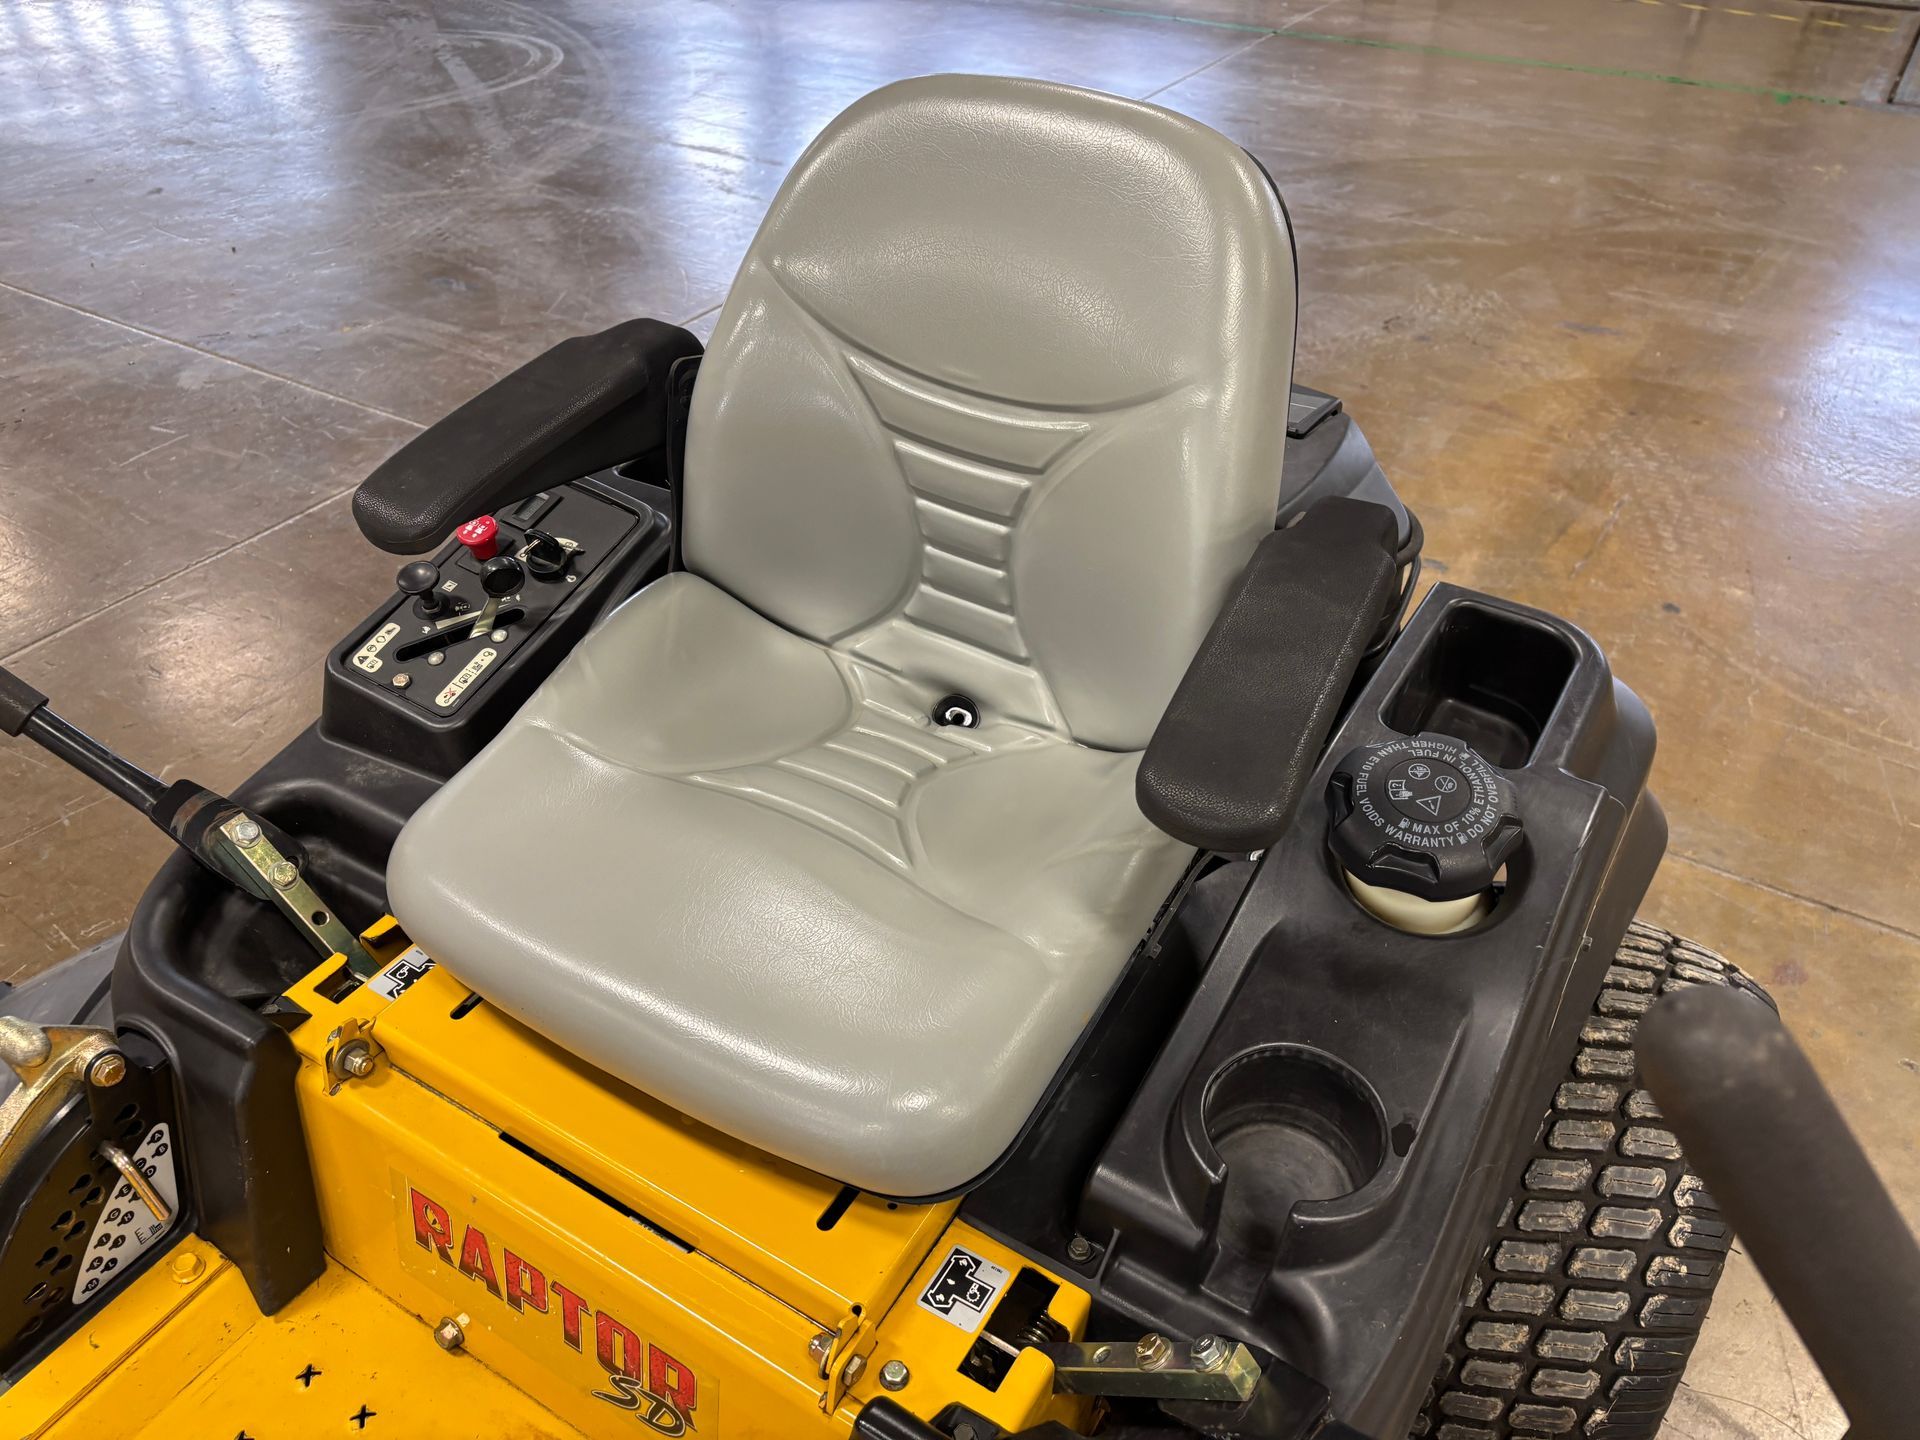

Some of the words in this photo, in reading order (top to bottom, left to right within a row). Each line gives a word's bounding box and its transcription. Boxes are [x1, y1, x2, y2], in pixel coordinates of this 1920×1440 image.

[1377, 742, 1410, 758] THAN
[1407, 749, 1440, 758] FUEL
[1411, 740, 1458, 755] HIGHER
[1362, 755, 1381, 771] E10
[1442, 753, 1457, 764] IN
[1356, 772, 1370, 797] FUEL
[1459, 761, 1485, 806] ETHANOL
[1471, 759, 1499, 804] OVERFILL
[1359, 797, 1385, 827] VOIDS
[1461, 806, 1482, 825] 10%
[1479, 804, 1498, 827] NOT
[1384, 823, 1455, 848] WARRANTY
[1411, 822, 1441, 835] MAX
[1443, 820, 1461, 833] OF
[1466, 823, 1485, 839] DO
[410, 1186, 698, 1432] RAPTOR
[592, 1375, 687, 1437] SD
